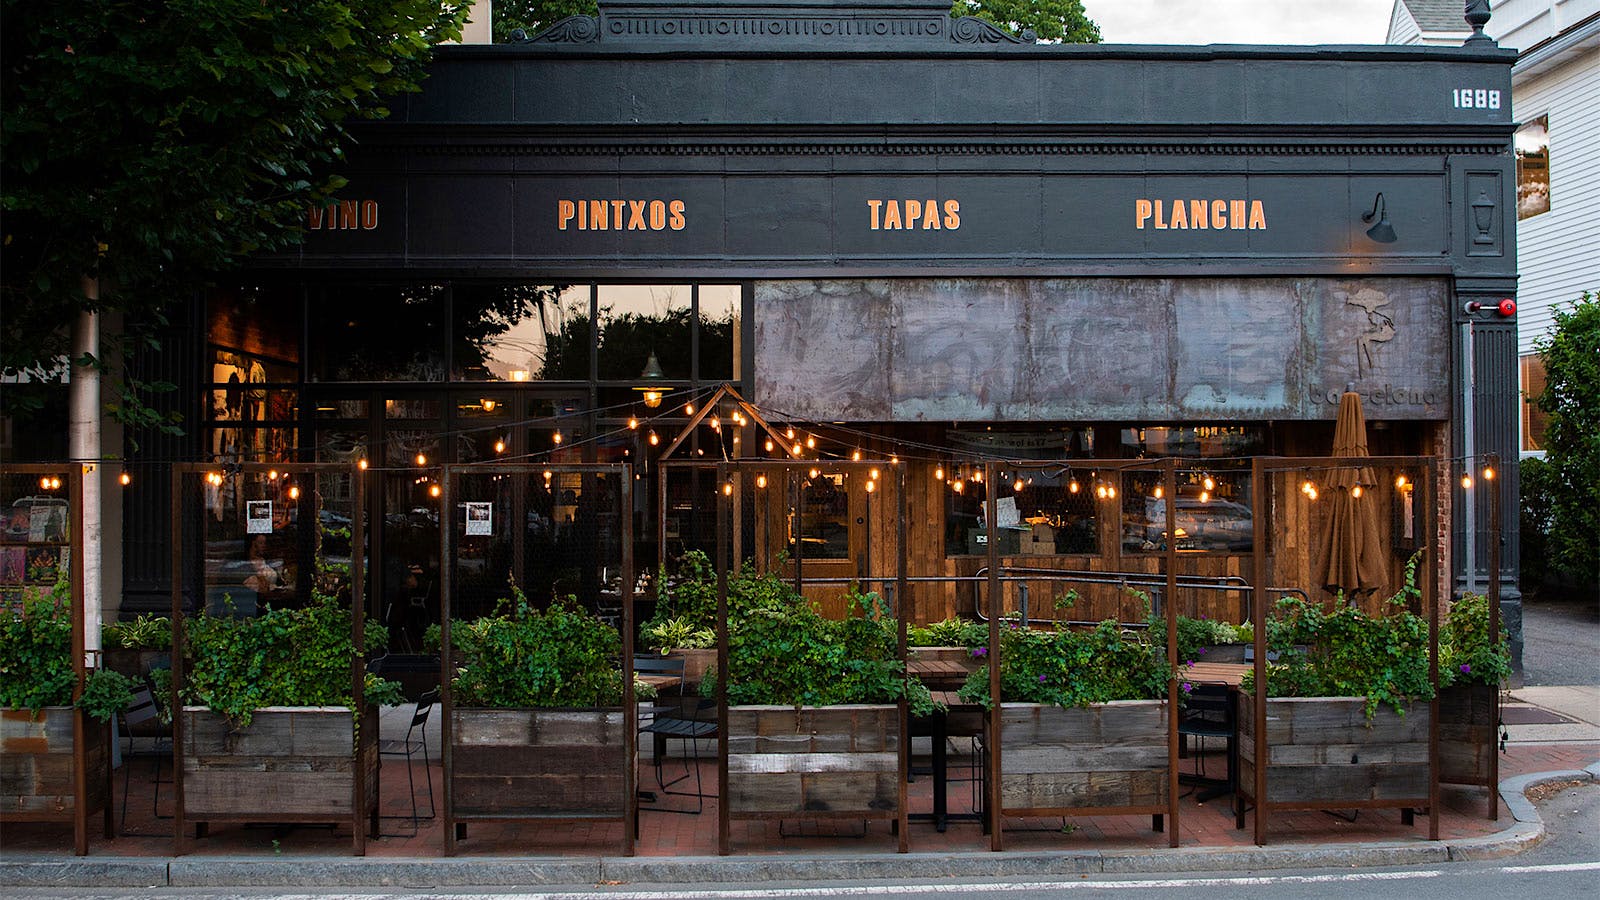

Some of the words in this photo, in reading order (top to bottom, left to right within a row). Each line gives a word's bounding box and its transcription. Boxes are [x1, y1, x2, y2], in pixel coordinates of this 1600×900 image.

[1453, 89, 1501, 109] 1688
[308, 199, 379, 230] VINO
[558, 199, 686, 231] PINTXOS
[867, 199, 961, 230] TAPAS
[1135, 199, 1267, 230] PLANCHA
[1309, 383, 1437, 406] baelona
